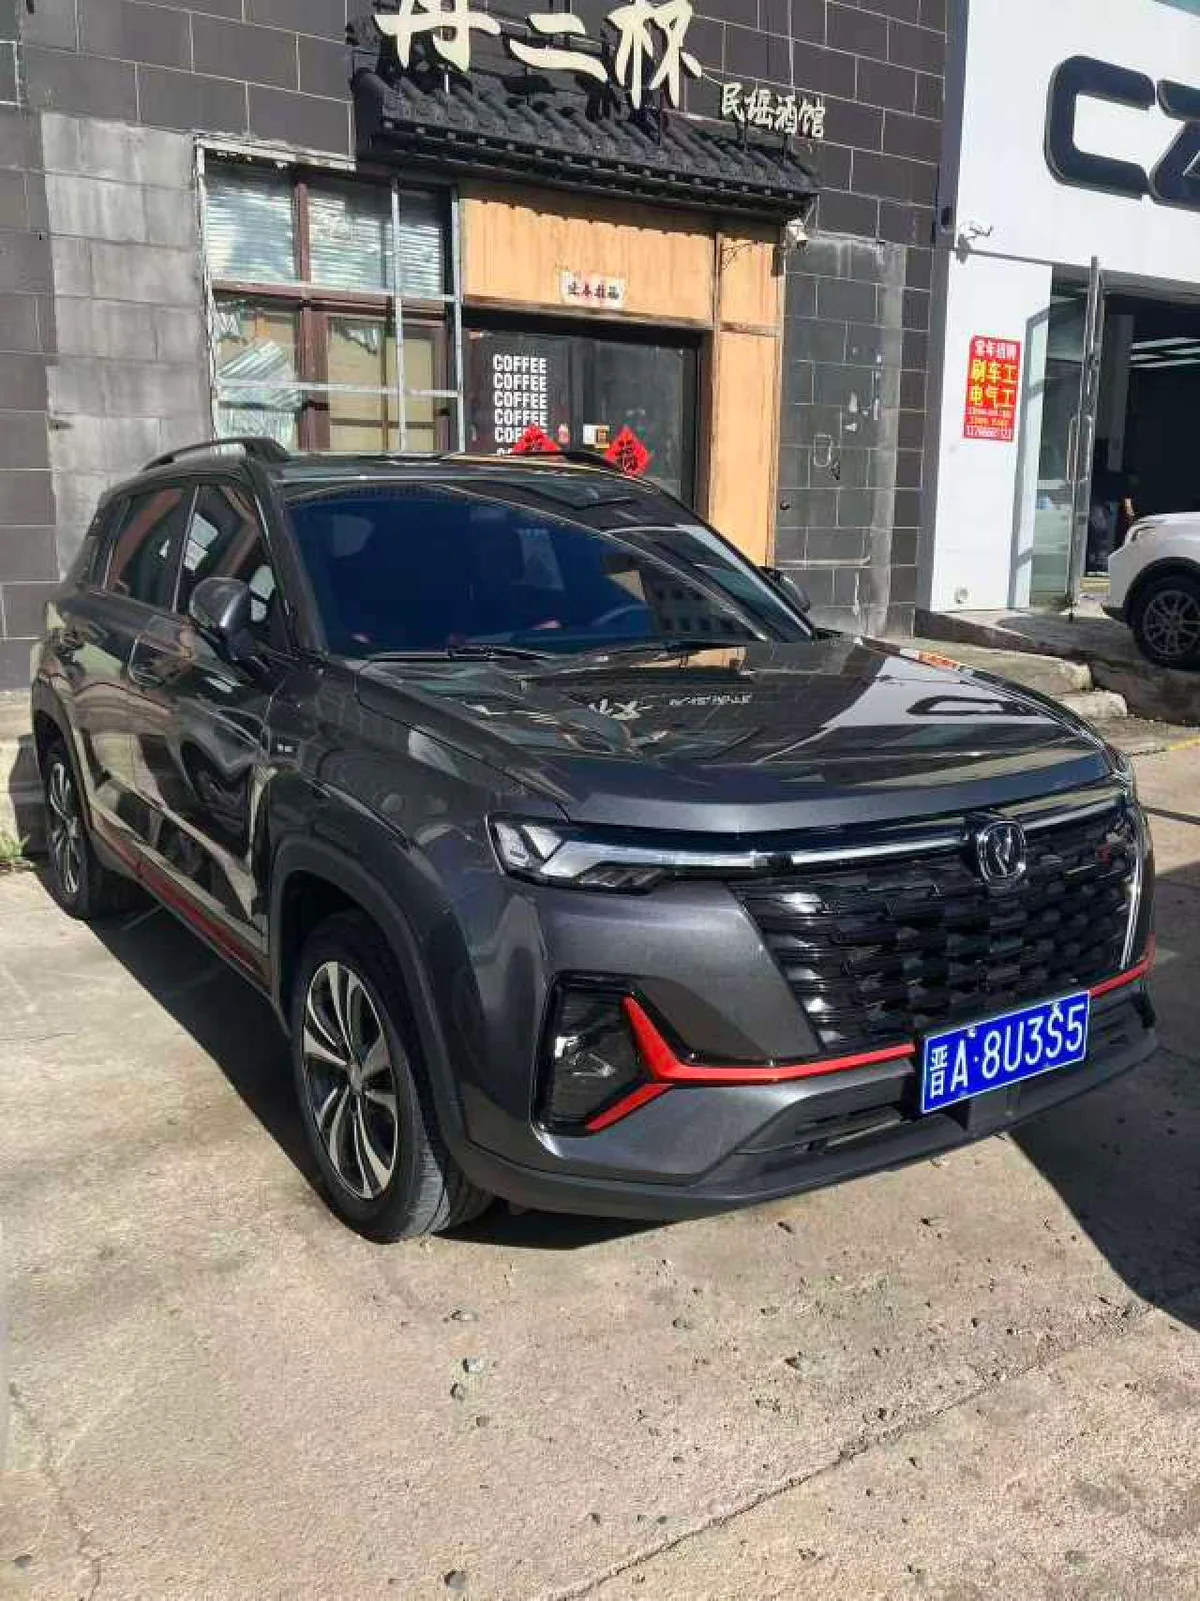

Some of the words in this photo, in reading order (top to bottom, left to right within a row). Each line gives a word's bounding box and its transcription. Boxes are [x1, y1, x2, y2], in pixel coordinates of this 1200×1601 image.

[493, 353, 548, 374] COFFEE
[493, 372, 548, 392] COFFEE
[494, 391, 548, 410] COFFEE
[970, 383, 1015, 410] 电气工
[494, 408, 548, 428] COFFEE
[494, 426, 548, 443] COF
